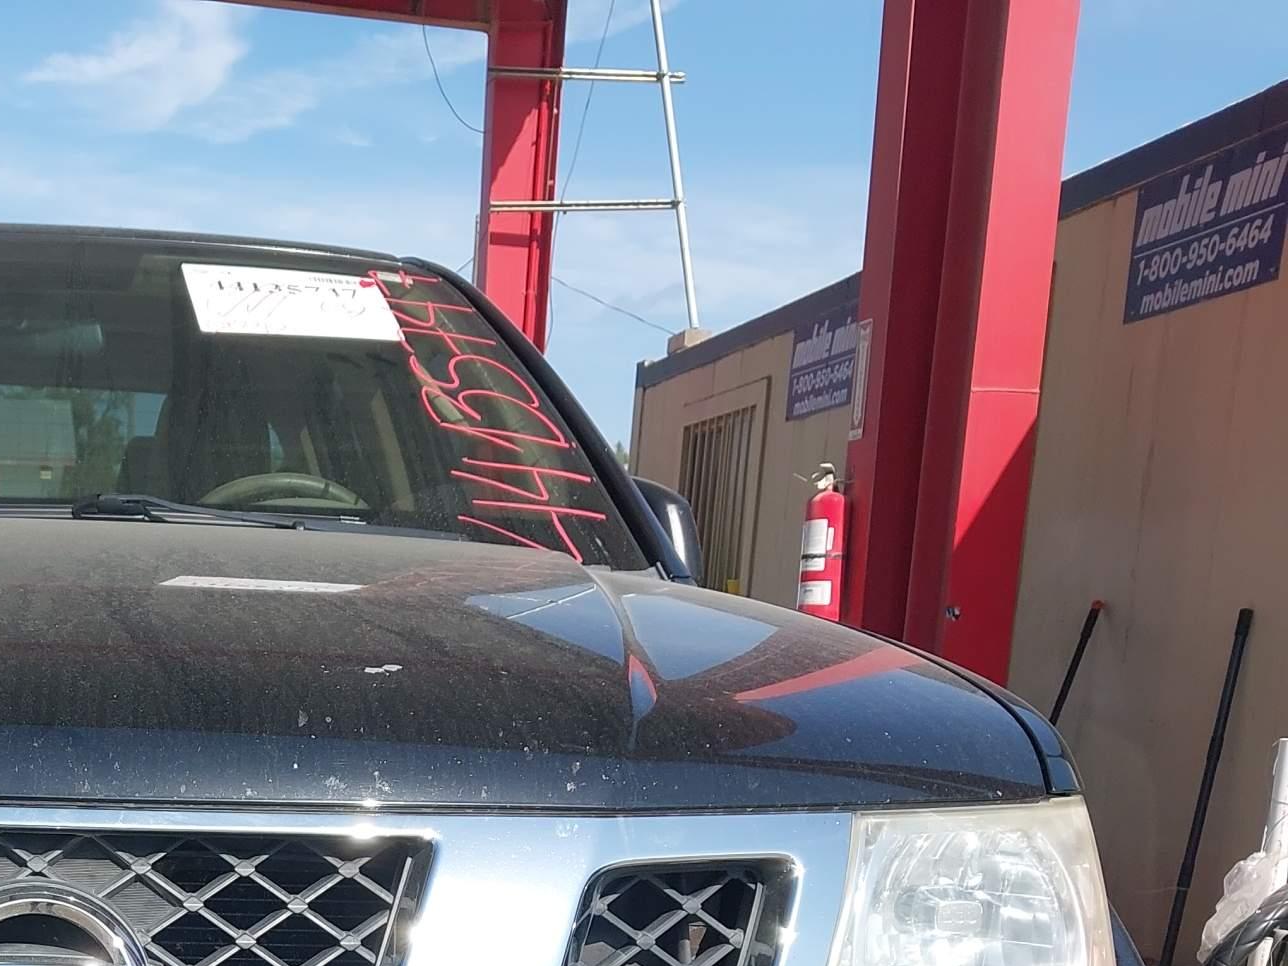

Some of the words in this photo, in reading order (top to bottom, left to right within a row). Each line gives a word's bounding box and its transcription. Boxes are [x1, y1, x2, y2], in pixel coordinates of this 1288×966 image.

[1136, 165, 1223, 248] mobile
[1220, 142, 1288, 217] mini
[1136, 213, 1275, 286] 1-800-950-6464
[1139, 259, 1260, 314] mobilemini.com
